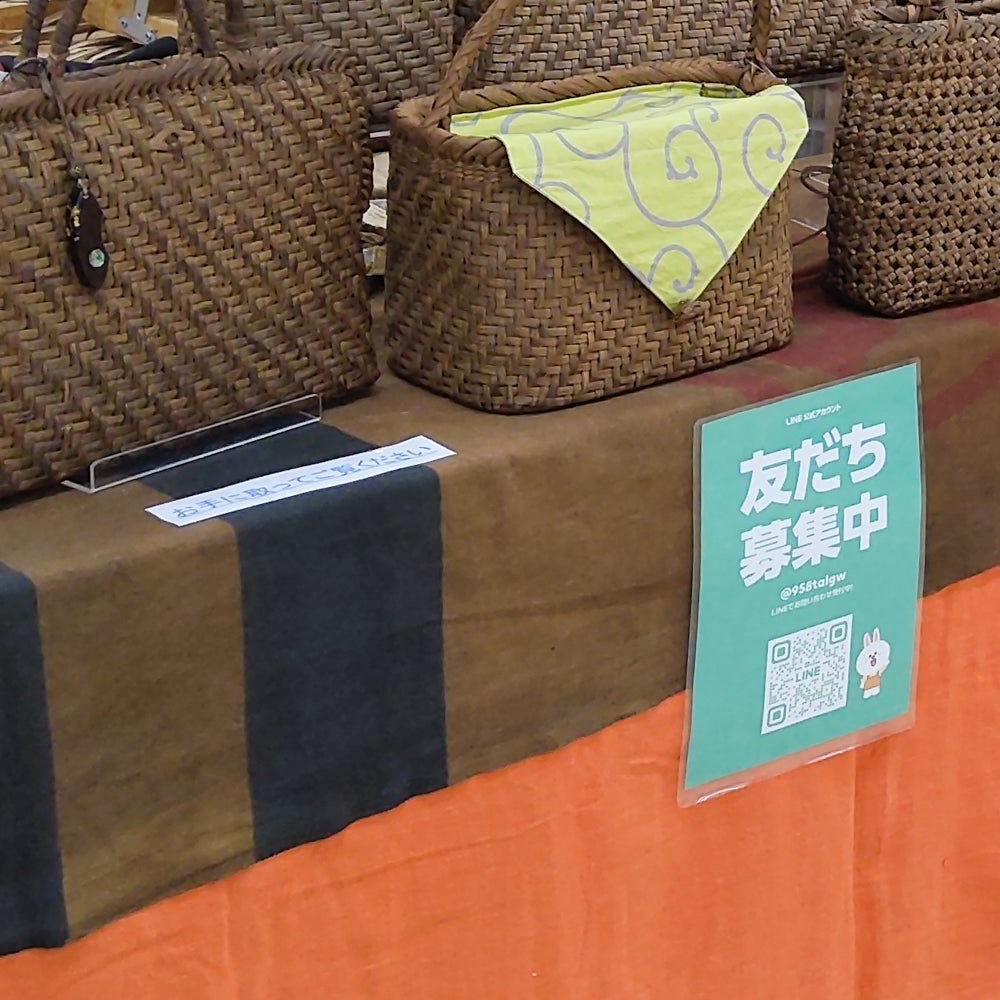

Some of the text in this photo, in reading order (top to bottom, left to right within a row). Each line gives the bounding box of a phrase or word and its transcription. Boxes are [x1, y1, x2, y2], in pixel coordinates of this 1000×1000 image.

[172, 444, 432, 519] お手に取ってご覧ください
[740, 422, 887, 516] 友だち
[740, 492, 888, 587] 募集中
[795, 665, 822, 683] LINE
